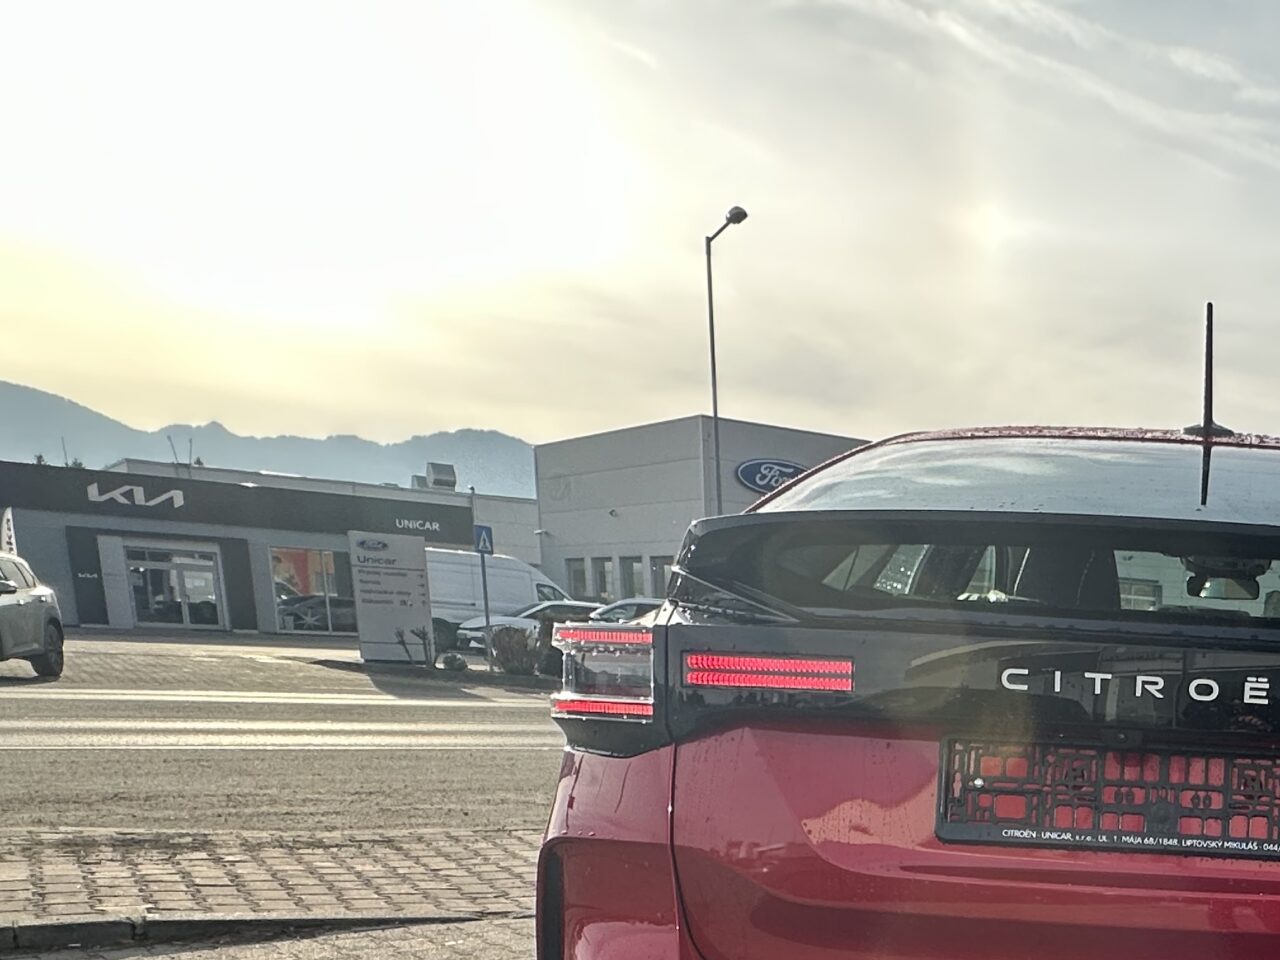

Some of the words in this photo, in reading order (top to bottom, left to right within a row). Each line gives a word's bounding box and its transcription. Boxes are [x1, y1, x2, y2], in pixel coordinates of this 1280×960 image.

[86, 482, 185, 509] KIA
[395, 518, 440, 531] UNICAR
[356, 555, 397, 566] Unicar
